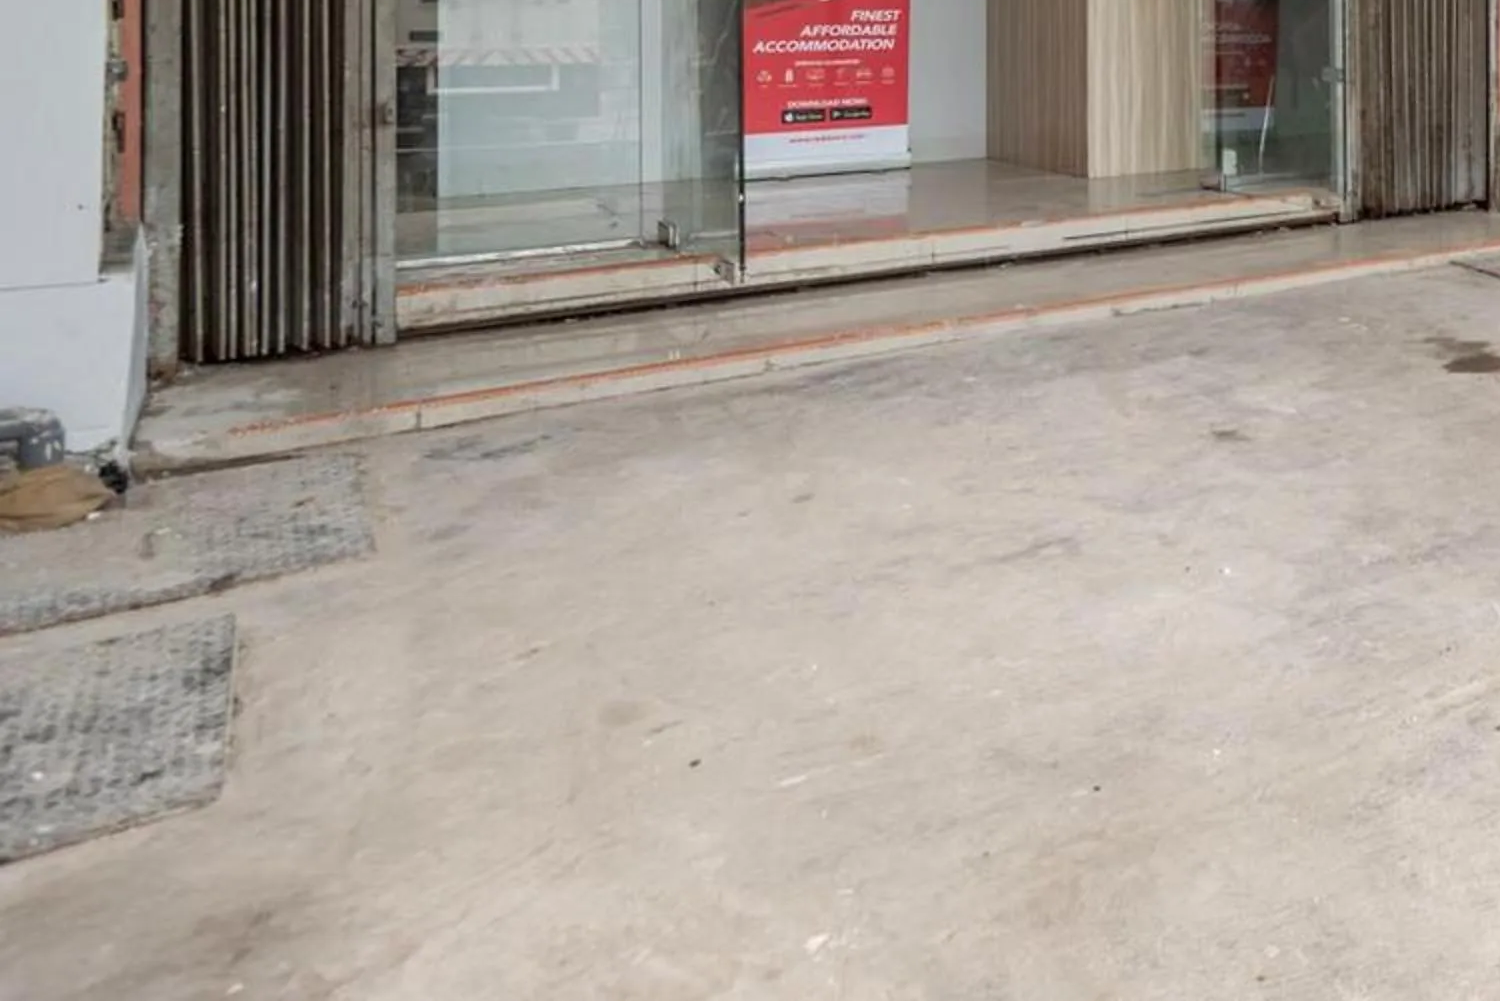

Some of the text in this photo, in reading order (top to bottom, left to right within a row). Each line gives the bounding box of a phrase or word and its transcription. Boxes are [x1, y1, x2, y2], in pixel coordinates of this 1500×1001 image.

[850, 9, 901, 22] FINEST
[800, 23, 897, 37] AFFORDABLE
[752, 38, 895, 54] ACCOMMODATION
